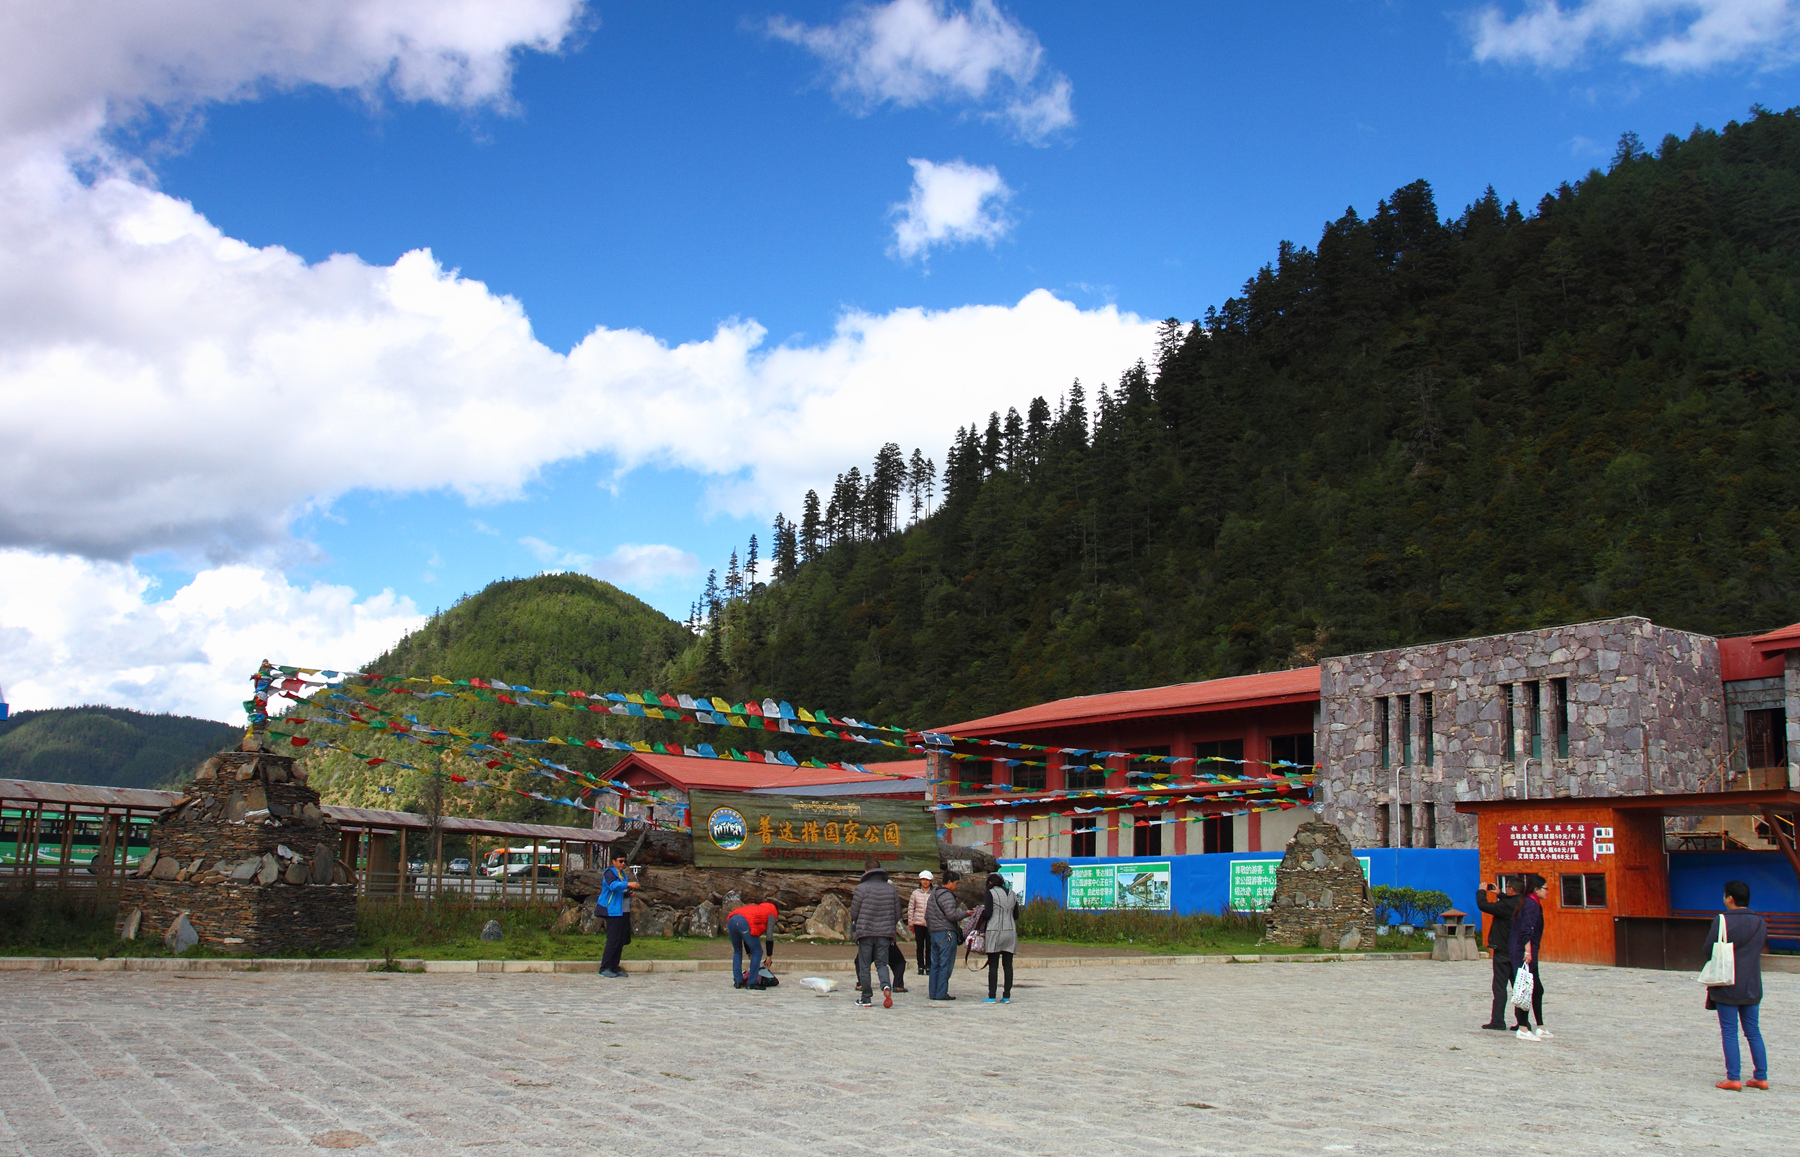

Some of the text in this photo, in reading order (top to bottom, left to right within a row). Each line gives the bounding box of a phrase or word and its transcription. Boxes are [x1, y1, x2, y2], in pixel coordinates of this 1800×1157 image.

[754, 814, 900, 847] 普达措国家公园
[815, 848, 868, 861] NATIONAL
[871, 850, 898, 862] PARK
